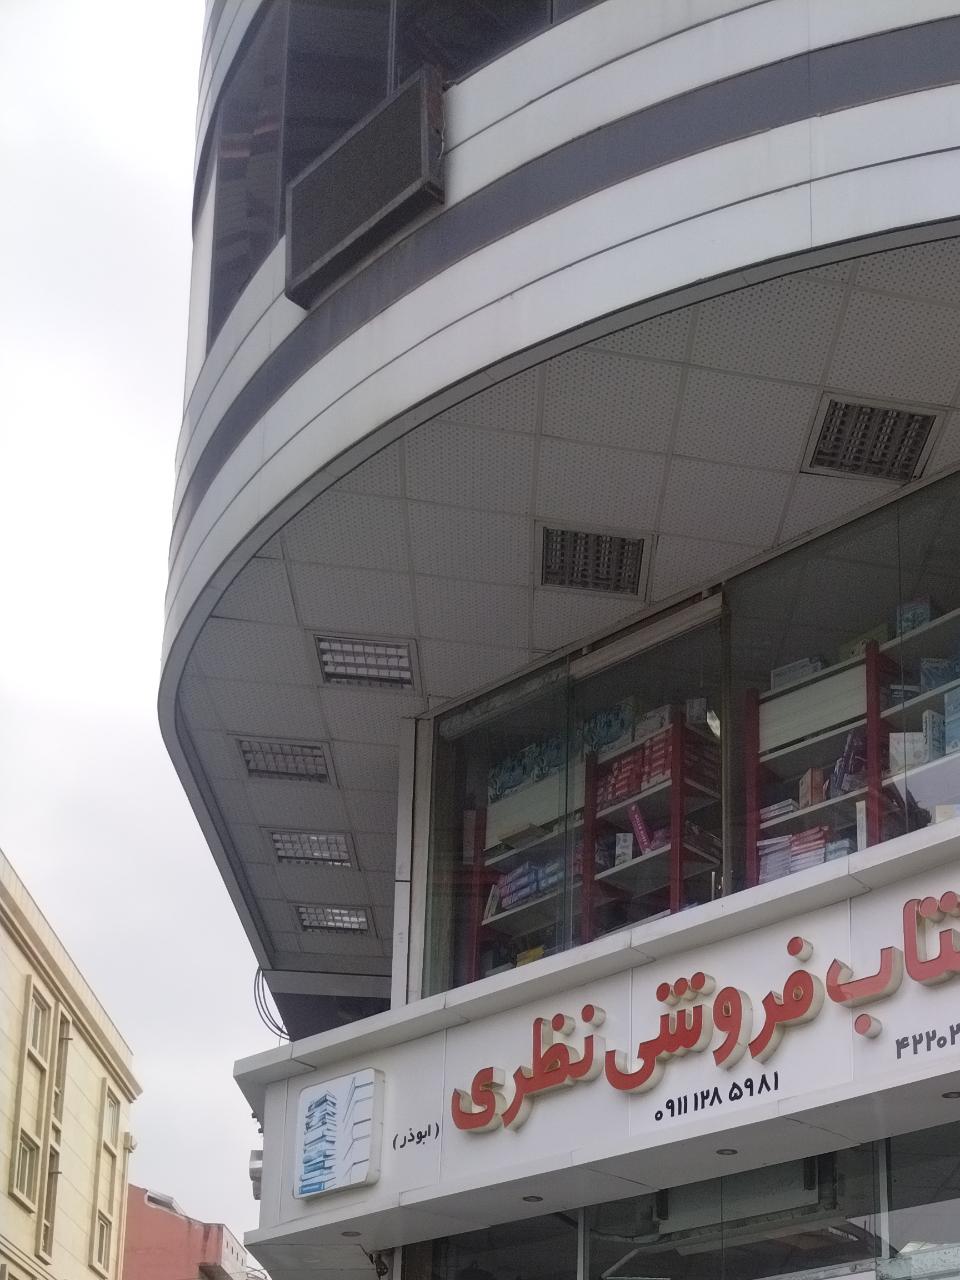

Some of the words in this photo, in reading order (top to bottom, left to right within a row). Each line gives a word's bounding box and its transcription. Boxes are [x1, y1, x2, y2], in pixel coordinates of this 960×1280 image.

[452, 1004, 606, 1135] نظری
[654, 1094, 688, 1121] ۰۹۱۱
[693, 1086, 723, 1111] ۱۲۸
[728, 1071, 779, 1101] ۵۹۸۱
